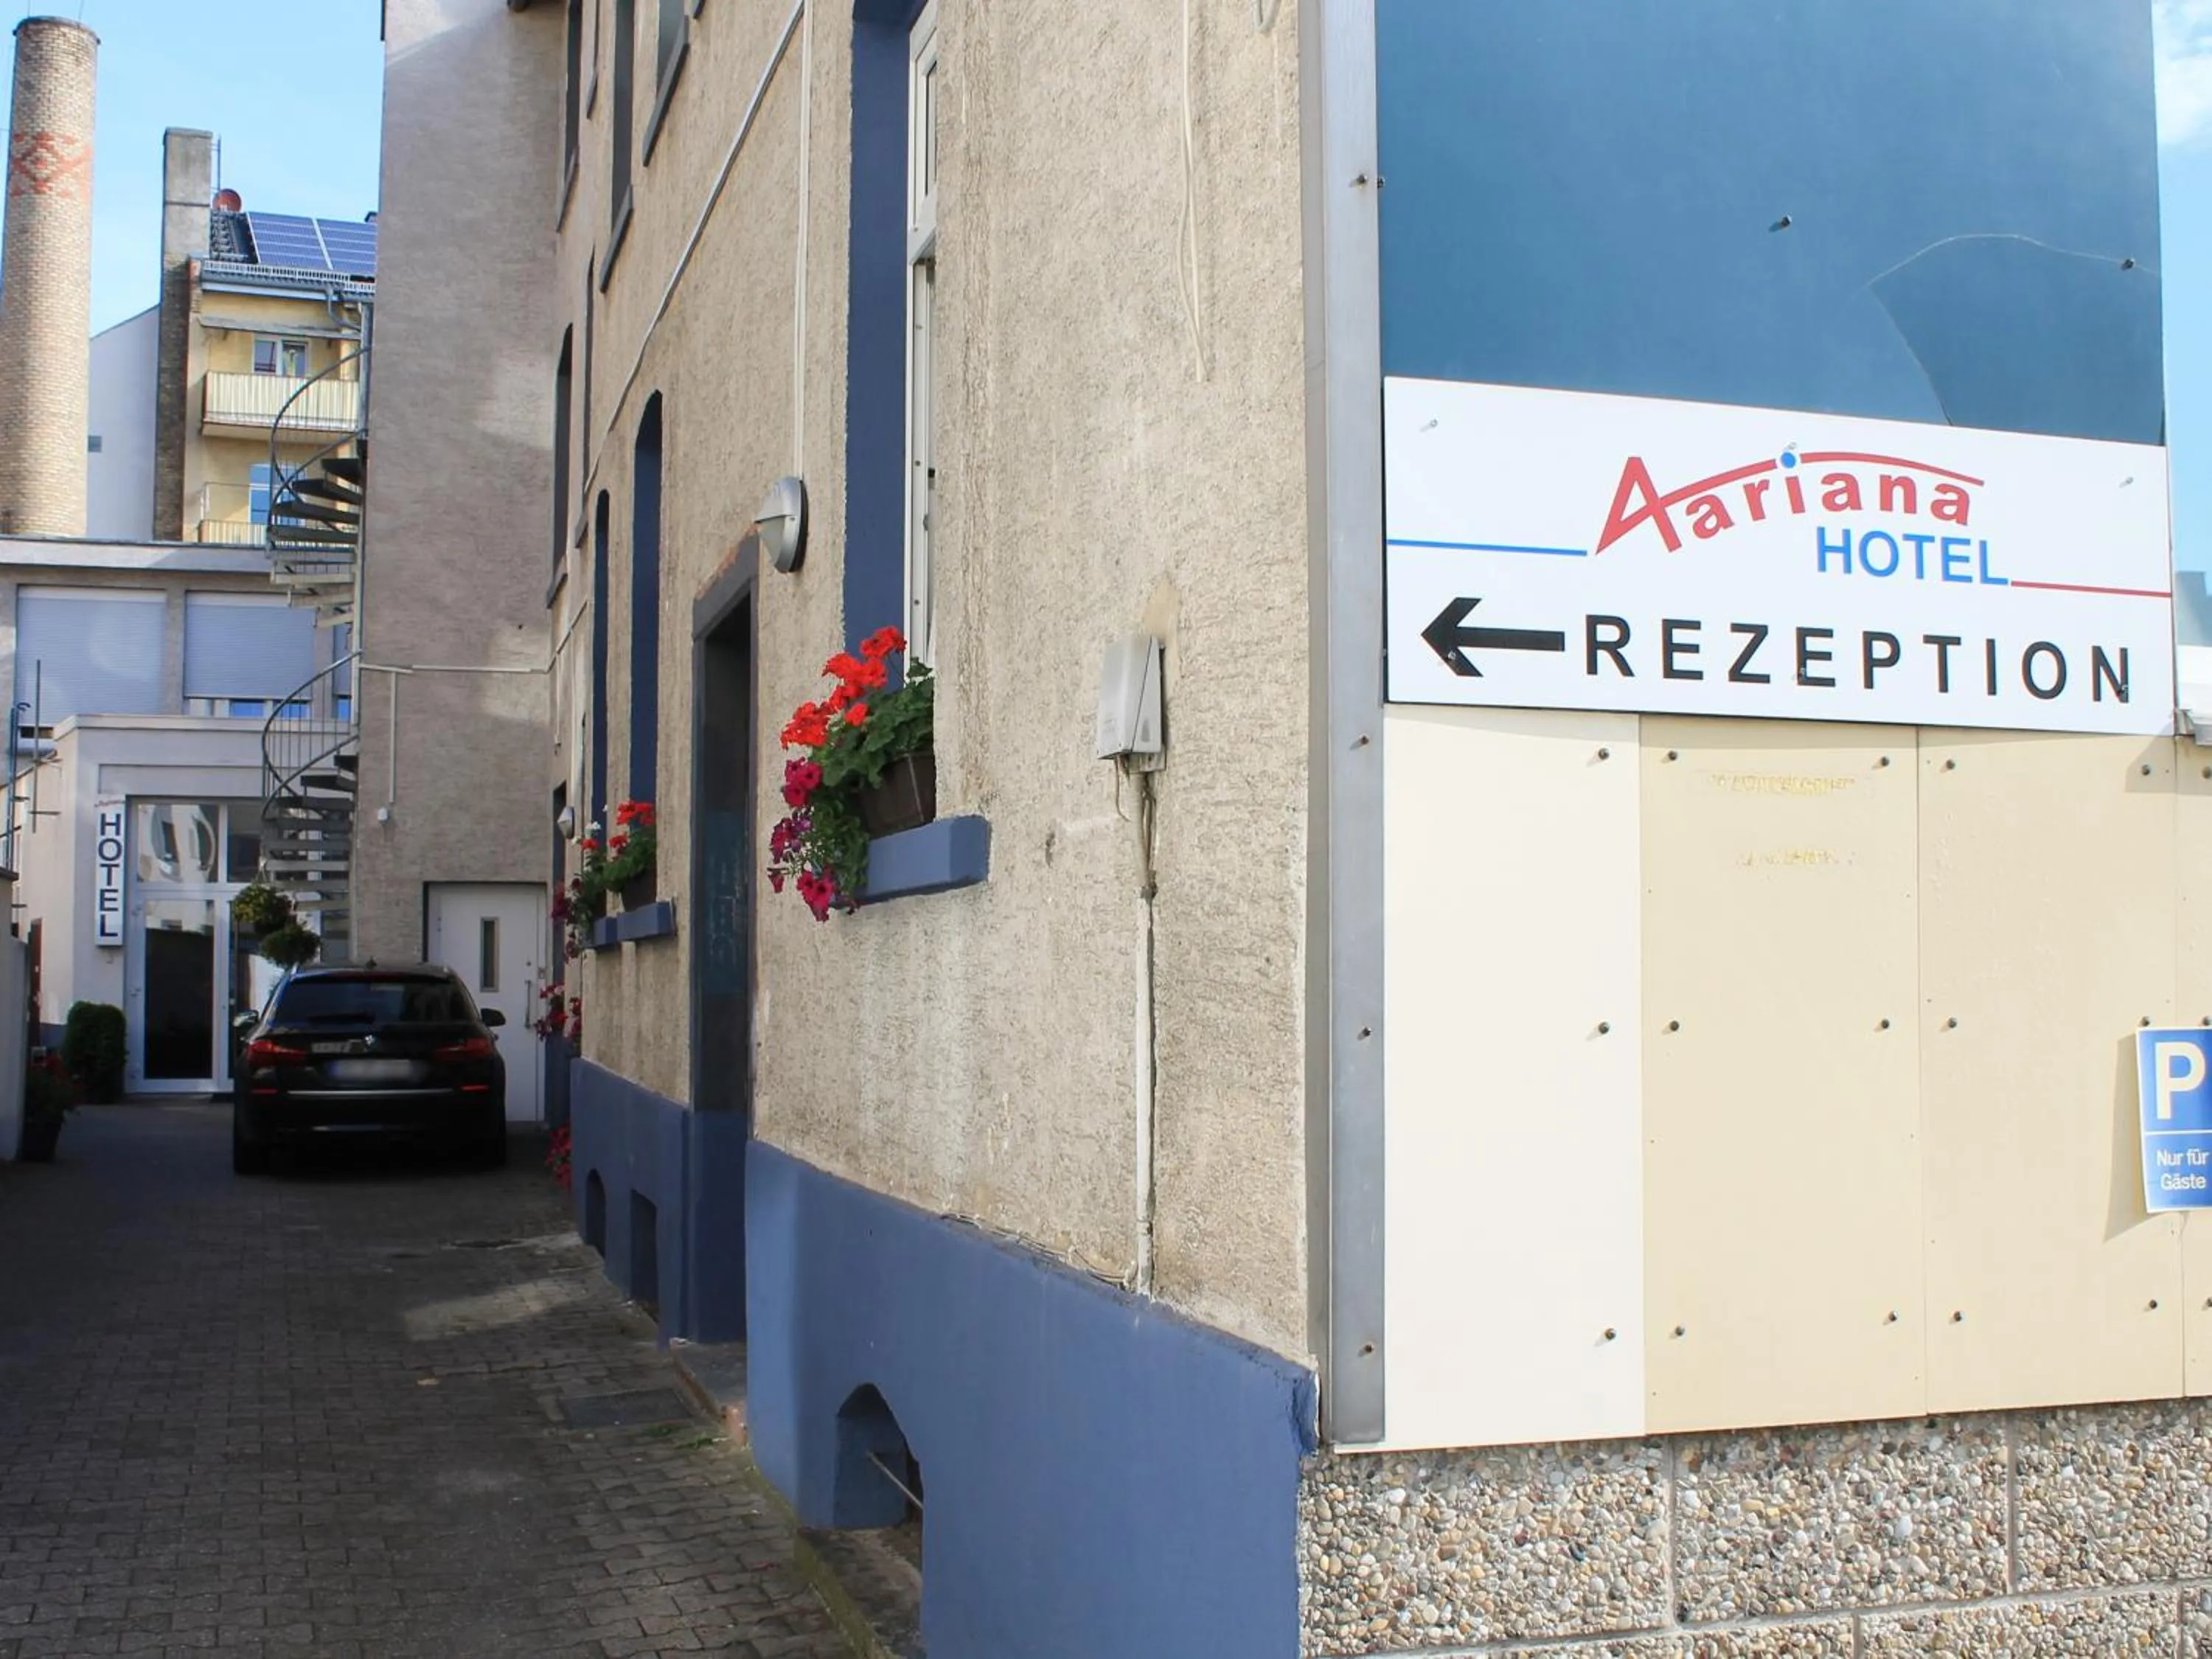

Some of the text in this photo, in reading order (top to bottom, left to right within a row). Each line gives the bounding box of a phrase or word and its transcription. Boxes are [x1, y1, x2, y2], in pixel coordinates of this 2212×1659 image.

[1596, 452, 1980, 553] Aariana
[1816, 526, 2007, 585] HOTEL
[1585, 614, 2129, 703] REZEPTION
[98, 813, 122, 936] HOTEL
[2155, 1041, 2206, 1120] P
[2157, 1148, 2209, 1166] Nur für
[2160, 1172, 2206, 1191] Gäste
